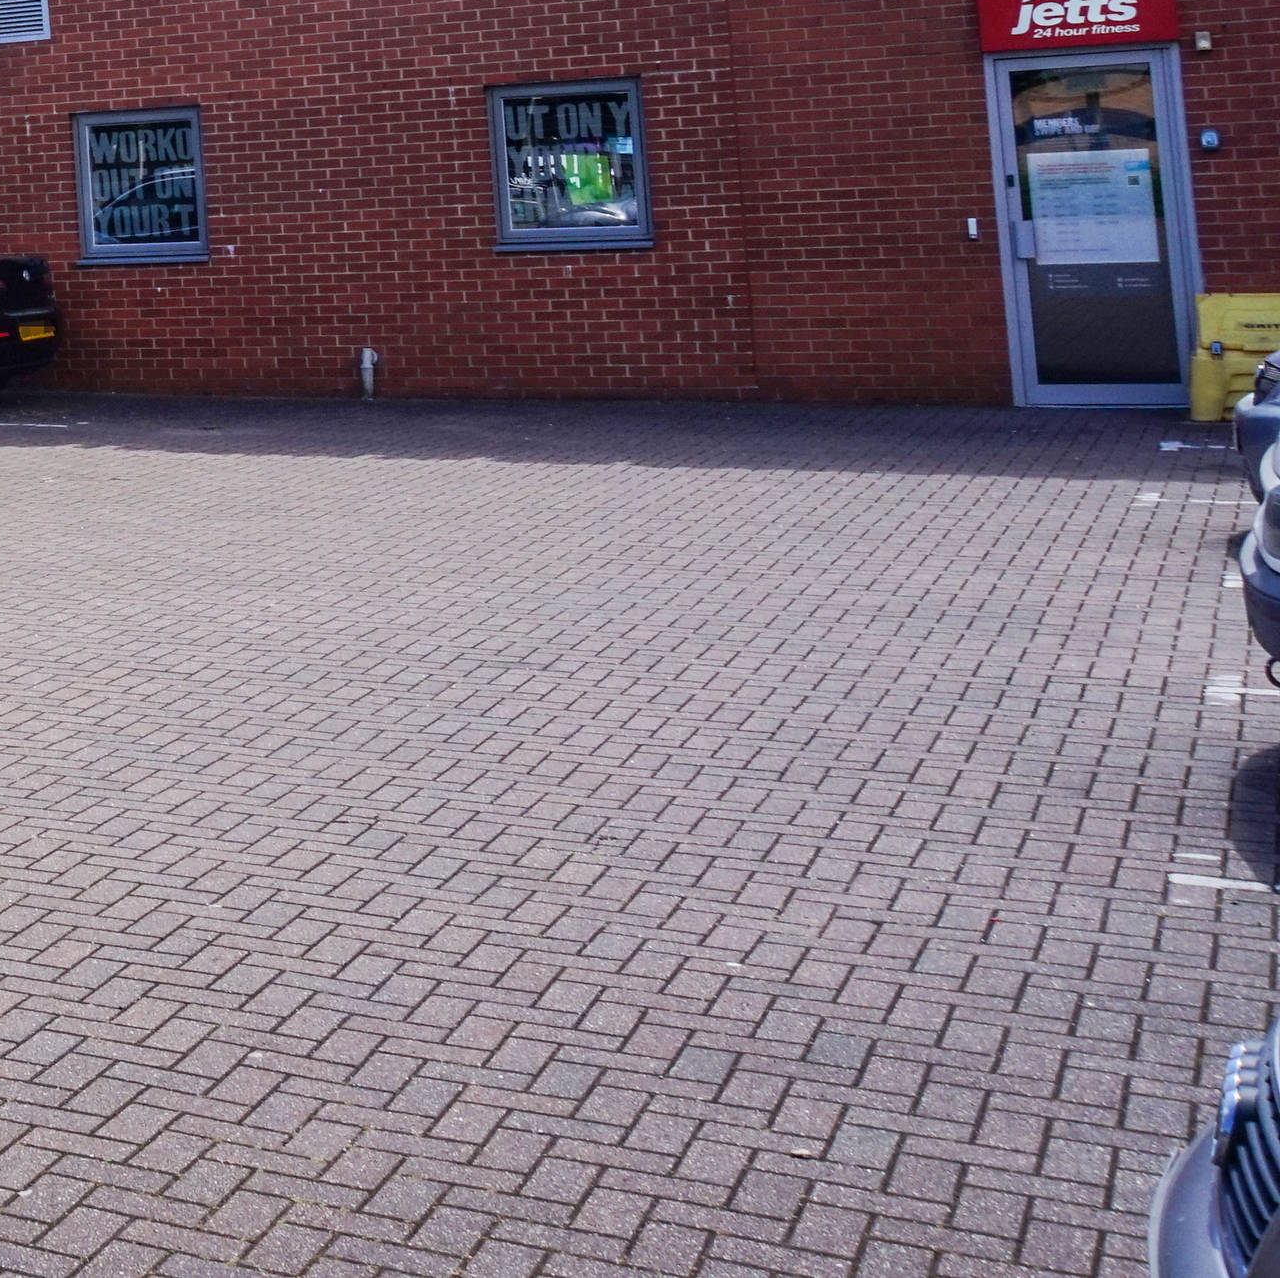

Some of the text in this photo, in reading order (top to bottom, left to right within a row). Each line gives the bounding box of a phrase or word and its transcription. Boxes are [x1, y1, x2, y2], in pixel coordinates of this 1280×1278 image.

[1033, 24, 1140, 38] 24 hour fitness
[556, 102, 602, 139] ON
[91, 127, 194, 164] WORKO
[93, 166, 194, 202] OUT ON
[95, 204, 195, 238] YOUR T
